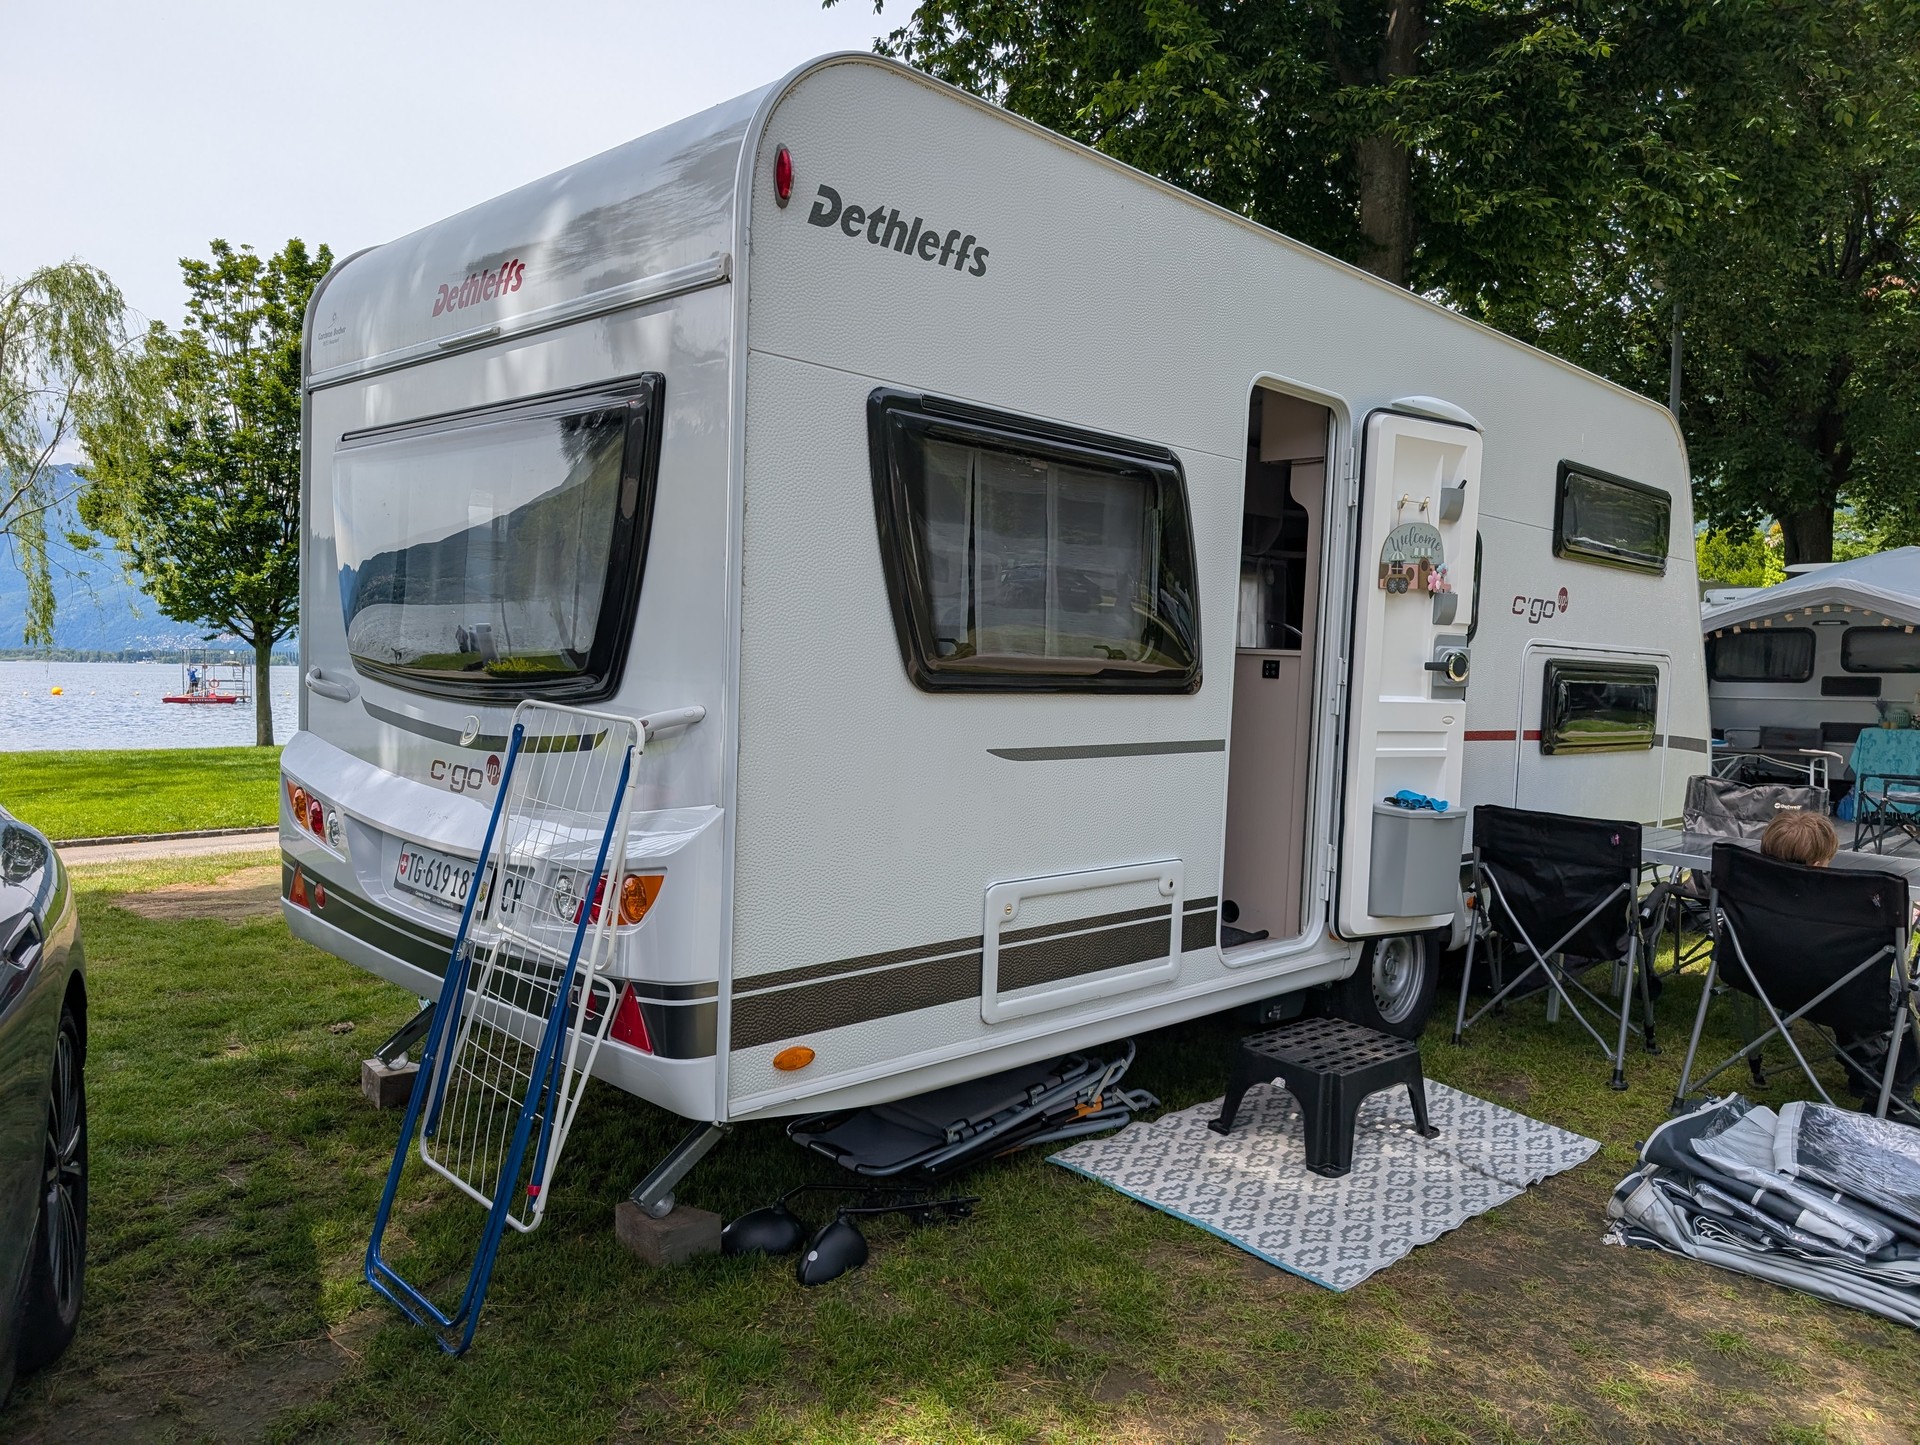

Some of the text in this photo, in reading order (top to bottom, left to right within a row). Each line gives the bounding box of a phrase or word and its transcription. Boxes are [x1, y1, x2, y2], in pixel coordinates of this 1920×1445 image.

[807, 183, 990, 277] Dethleffs
[432, 258, 526, 317] Dethleffs
[1390, 526, 1440, 552] Welcome
[501, 878, 525, 914] CH
